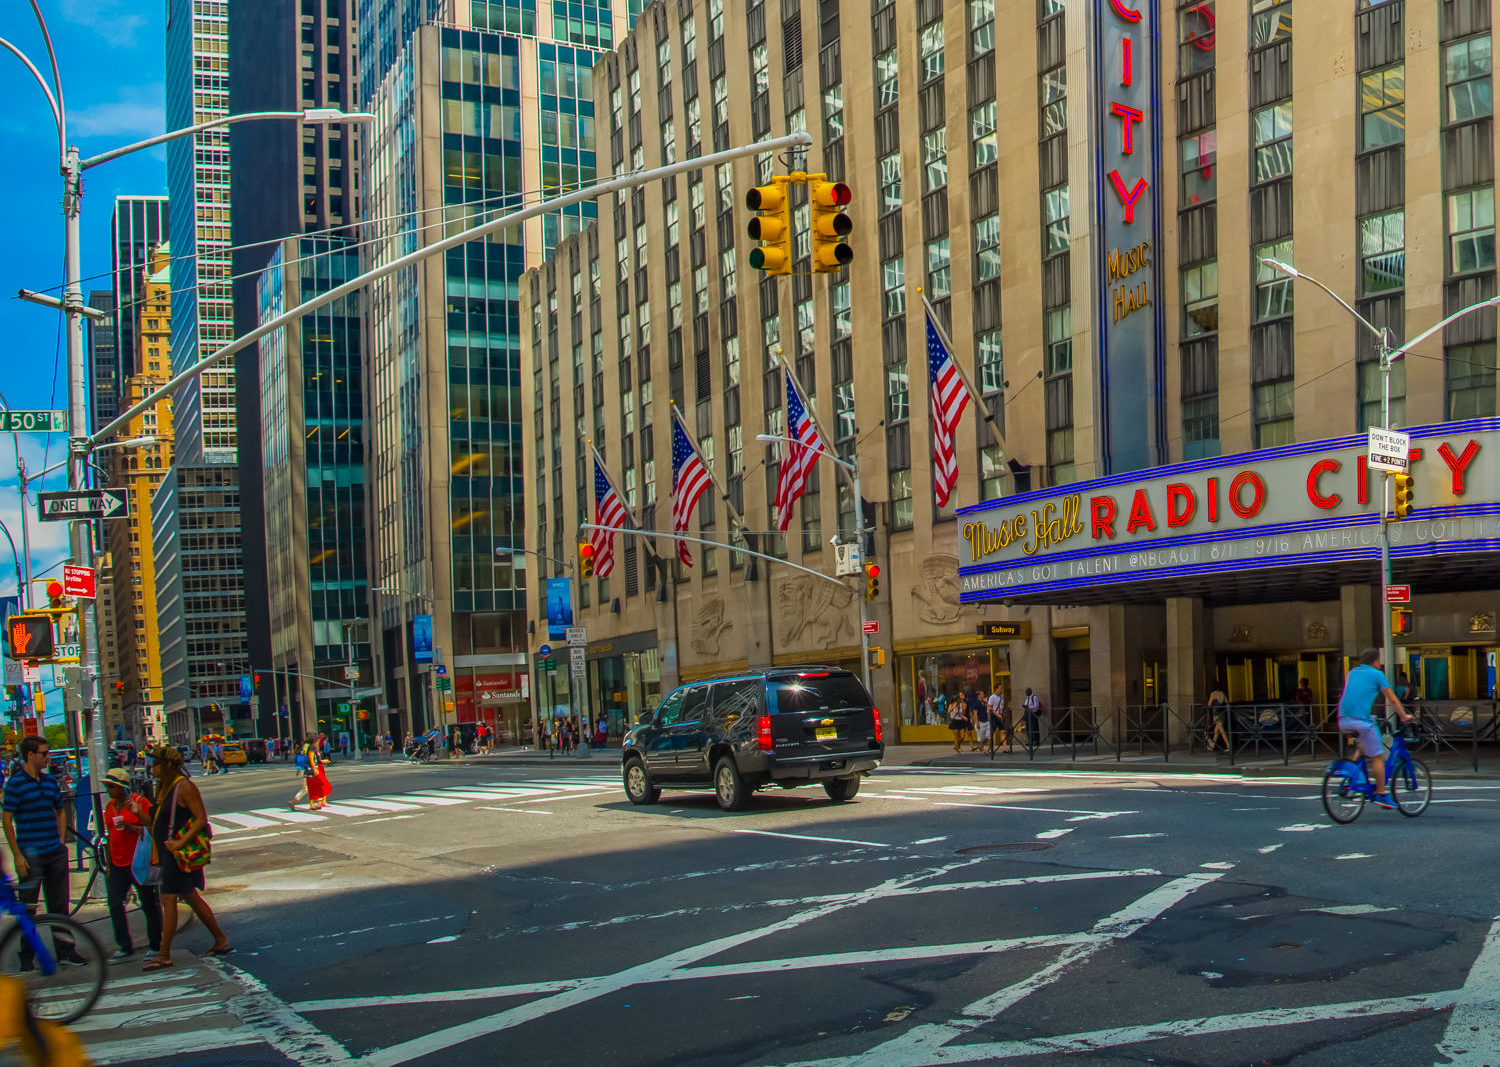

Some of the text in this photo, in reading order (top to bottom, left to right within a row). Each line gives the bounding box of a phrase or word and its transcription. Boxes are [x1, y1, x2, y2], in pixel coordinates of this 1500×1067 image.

[1107, 240, 1151, 285] MUSIC
[1113, 281, 1152, 323] HALL
[10, 413, 35, 430] 50
[37, 413, 49, 422] ST
[1372, 433, 1407, 446] DON'T BLOCK
[1378, 442, 1401, 453] THE BOX
[1371, 454, 1382, 463] FINE
[1391, 456, 1406, 466] POINTS
[51, 498, 114, 512] ONE WAY
[963, 511, 1027, 561] Music
[1022, 494, 1084, 555] Hall
[1091, 470, 1266, 540] RADIO
[1306, 439, 1480, 510] CIY
[963, 571, 1024, 591] AMERICA'S
[1032, 566, 1059, 581] GOT
[1069, 556, 1119, 576] TALENT
[1129, 547, 1199, 567] @NBCAGT
[1256, 536, 1289, 555] 9/16
[1303, 524, 1402, 550] AMERICAS
[1416, 520, 1457, 541] GOT
[991, 626, 1015, 634] Subway
[491, 690, 521, 699] Santande
[339, 703, 349, 712] TD
